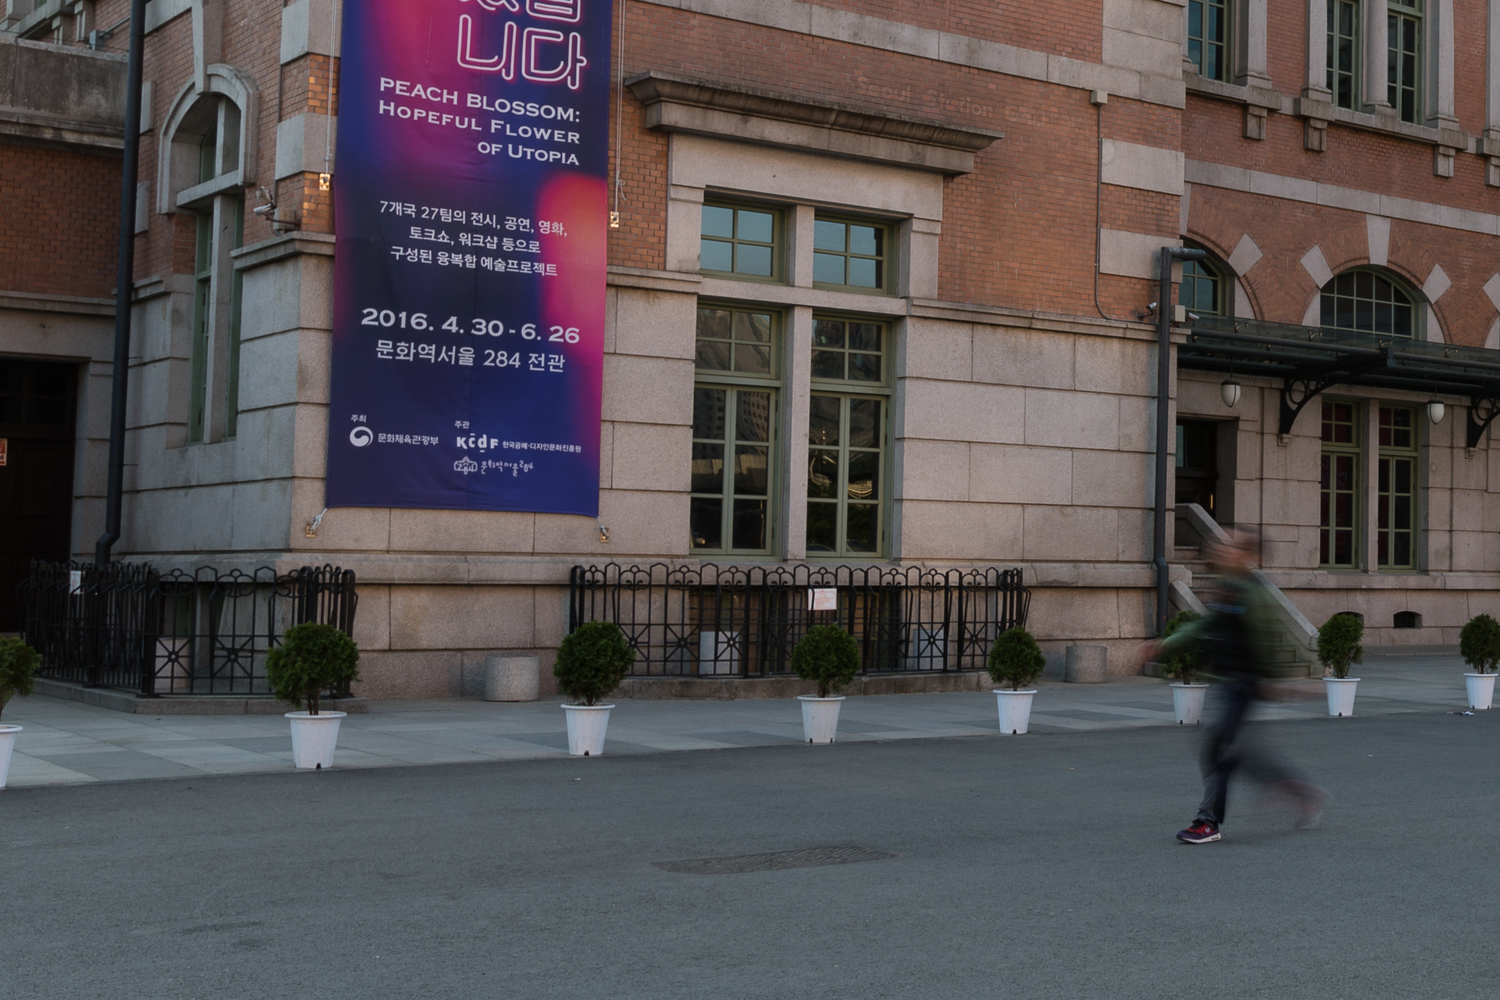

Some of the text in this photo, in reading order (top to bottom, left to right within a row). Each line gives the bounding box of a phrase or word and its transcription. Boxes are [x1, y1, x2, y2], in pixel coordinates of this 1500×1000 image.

[457, 14, 587, 90] 니다
[380, 77, 580, 122] PEACH BLOSSOM:
[379, 100, 580, 144] HOPEFUL FLOWER
[508, 144, 580, 165] UTOPIA
[380, 201, 568, 237] 7개국 27팀의 전시, 공연, 영화,
[409, 226, 541, 253] 토크쇼, 워크샵 등으로
[390, 246, 558, 276] 구성된 융복합 예술프로젝트
[361, 308, 434, 331] 2016.
[442, 316, 464, 334] 4.
[471, 318, 504, 337] 30
[521, 323, 541, 341] 6.
[549, 325, 580, 344] 26
[376, 339, 565, 372] 문화역서울 284 전관
[351, 414, 367, 423] 주최
[454, 420, 470, 429] 주관
[378, 433, 439, 446] 문화체육관광부
